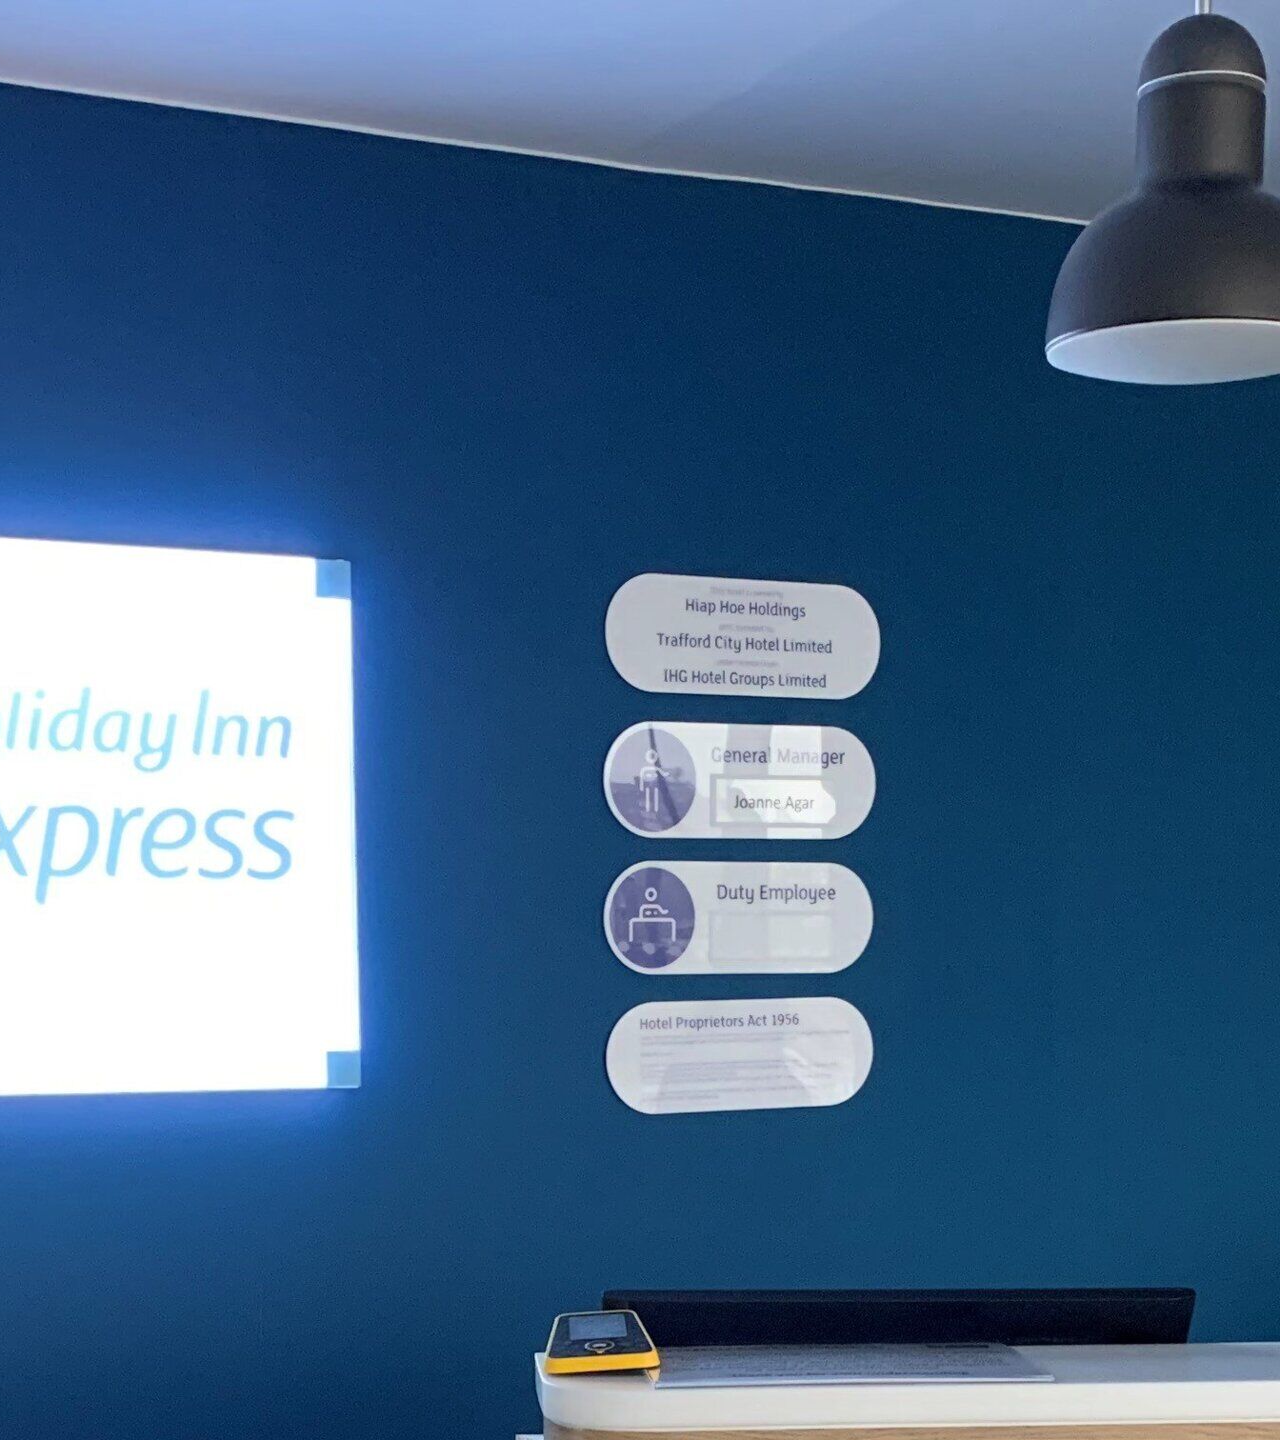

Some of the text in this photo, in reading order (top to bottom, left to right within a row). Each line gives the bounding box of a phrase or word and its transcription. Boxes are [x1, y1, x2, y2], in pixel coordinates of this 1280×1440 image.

[685, 598, 806, 620] Hiap Hoe Holdings
[656, 632, 832, 654] Trafford City Hotel Limited
[663, 669, 827, 690] IHG Hotel Groups Limited
[192, 688, 292, 758] Inn
[711, 746, 846, 769] General Manager
[733, 794, 816, 812] Joanne Agar
[716, 883, 837, 905] Duty Employee
[639, 1013, 799, 1031] Hotel Proprietors Act 1956
